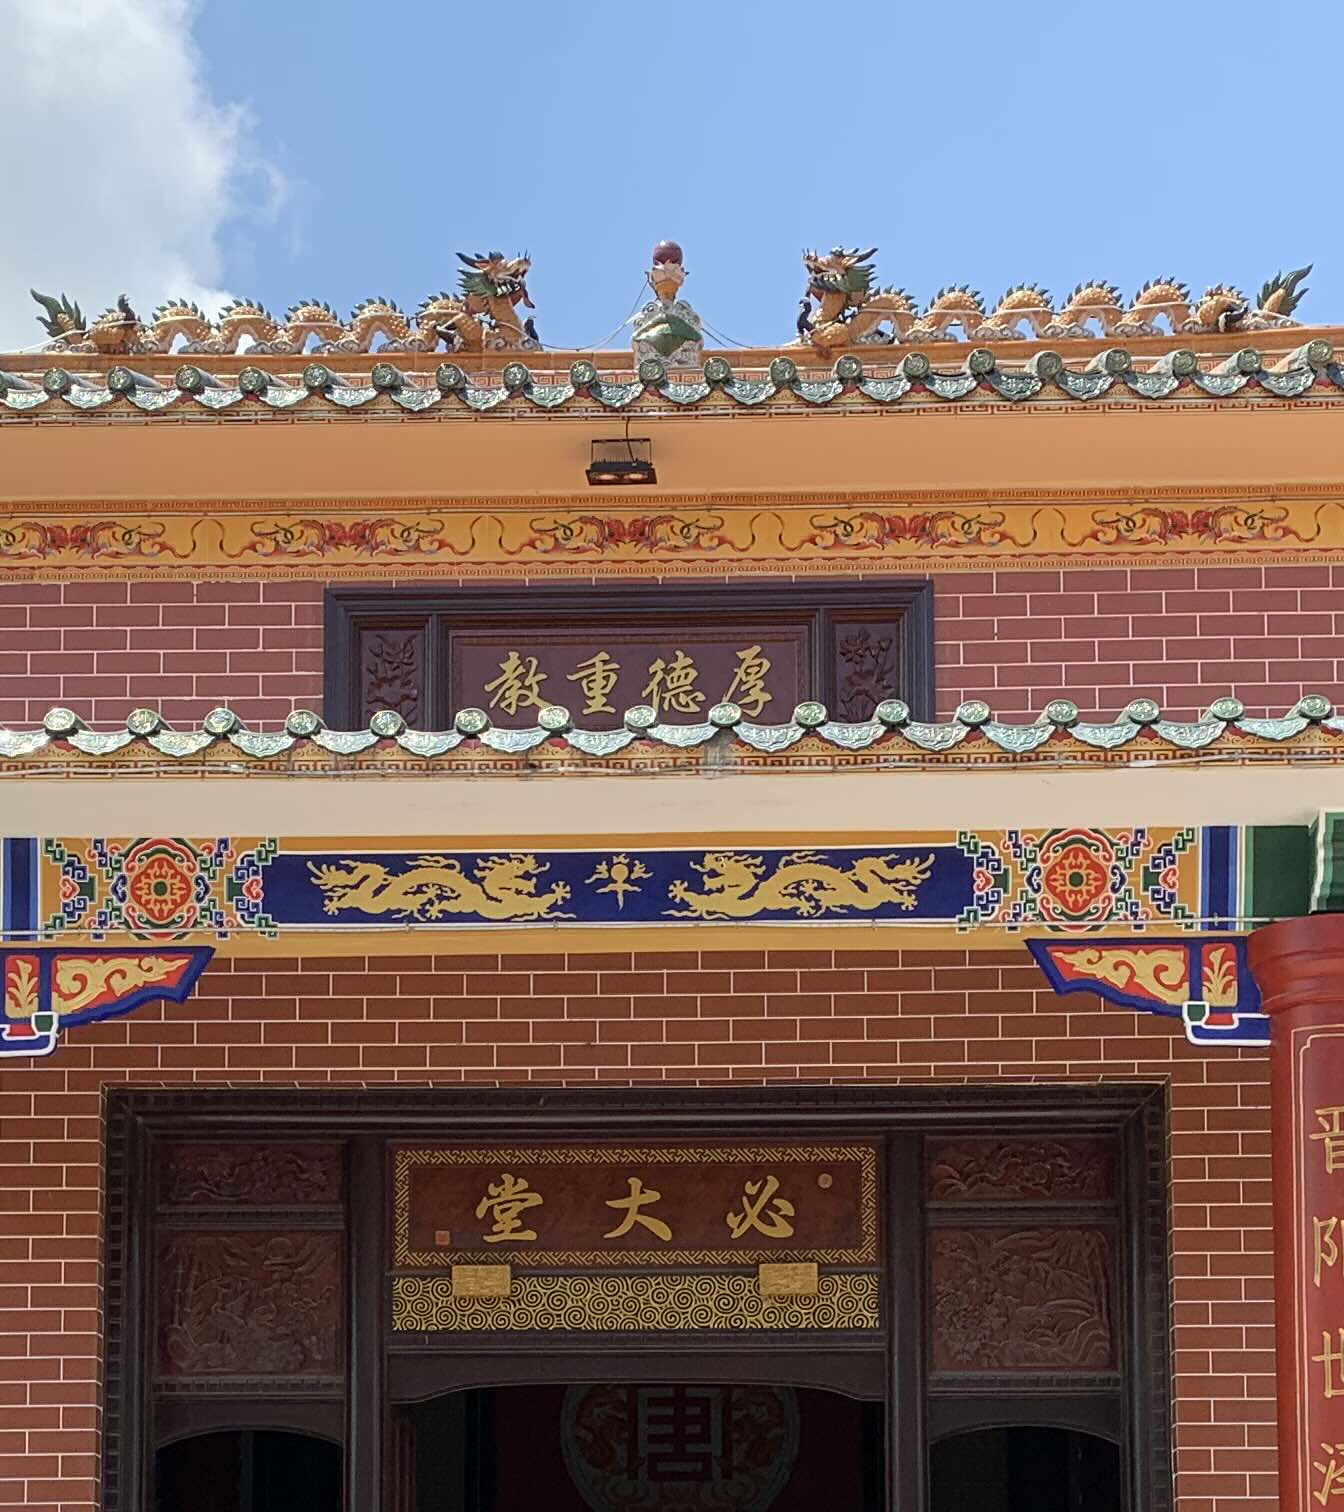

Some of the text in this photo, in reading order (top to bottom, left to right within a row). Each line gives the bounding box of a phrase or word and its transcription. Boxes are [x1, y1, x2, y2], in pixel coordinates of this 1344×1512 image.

[483, 645, 773, 717] 厚德重教
[474, 1173, 796, 1243] 必大堂
